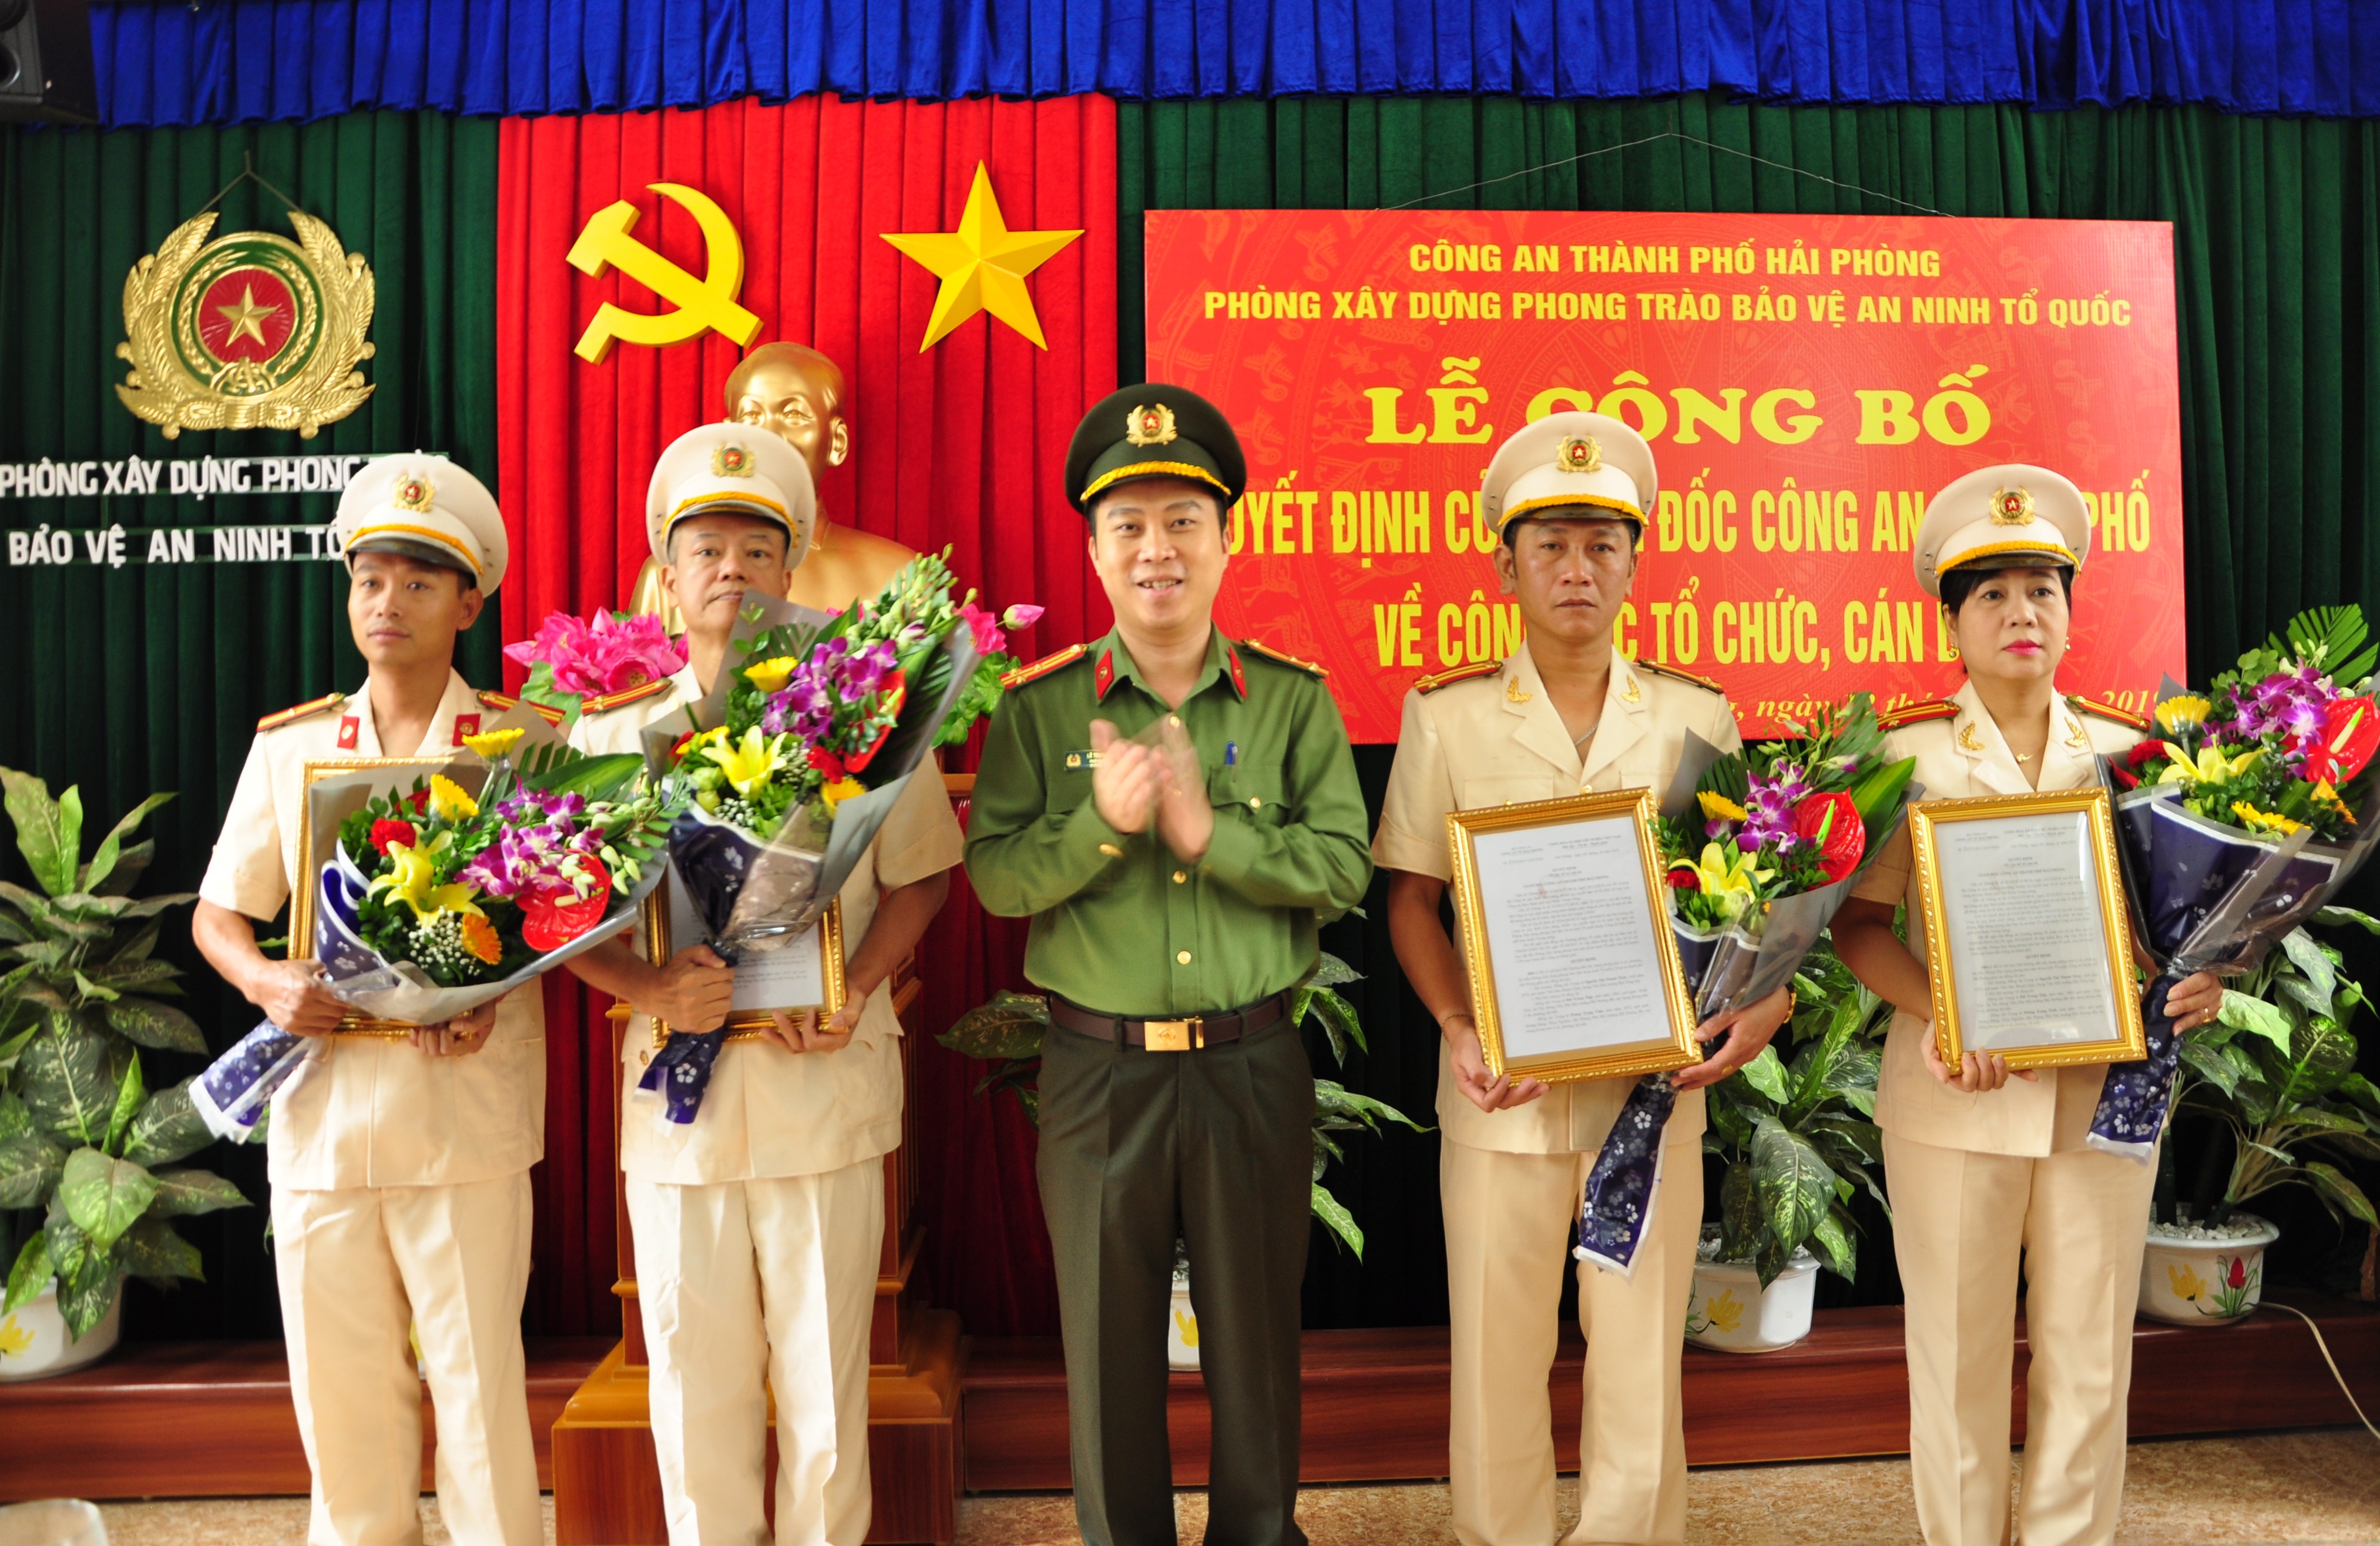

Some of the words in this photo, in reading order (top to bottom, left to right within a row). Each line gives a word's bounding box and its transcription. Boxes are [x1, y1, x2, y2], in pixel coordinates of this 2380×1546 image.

[1409, 238, 1502, 272] CÔNG
[1512, 245, 1559, 273] AN
[1569, 240, 1679, 273] THÀNH
[1690, 237, 1756, 274] PHỐ
[1766, 239, 1820, 275] HẢI
[1831, 243, 1941, 277] PHÒNG
[1204, 284, 1321, 319] PHÒNG
[1332, 286, 1398, 319] XÂY
[1409, 289, 1501, 326] DỰNG
[1512, 292, 1626, 320] PHONG
[1636, 287, 1721, 321] TRÀO
[1731, 285, 1797, 322] BẢO
[1807, 289, 1847, 328] VỆ
[1856, 296, 1901, 323] AN
[1912, 296, 1990, 324] NINH
[1999, 287, 2039, 326] TỔ
[2048, 290, 2131, 329] QUỐC
[1362, 356, 1493, 445] LỄ
[1526, 369, 1825, 445] CÔNG
[1854, 363, 1992, 447] BỐ
[0, 457, 99, 497] PHÒNG
[102, 454, 163, 495] XÂY
[170, 454, 251, 501] DỰNG
[1657, 467, 1737, 553] ĐỐC
[1751, 477, 1859, 553] CÔNG
[1871, 490, 1925, 552] AN
[9, 523, 73, 565] BẢO
[85, 523, 127, 569] VỆ
[147, 529, 195, 564] AN
[213, 528, 291, 562] NINH
[1226, 469, 1318, 554] UYẾT
[1330, 490, 1430, 568] ĐỊNH
[1445, 468, 1503, 554] CỦ
[1373, 582, 1424, 667] VỀ
[1438, 589, 1527, 667] CÔN
[1650, 575, 1699, 665] TỔ
[1713, 588, 1831, 672] CHỨC,
[1844, 587, 1924, 663] CÁN
[2102, 689, 2160, 713] 201
